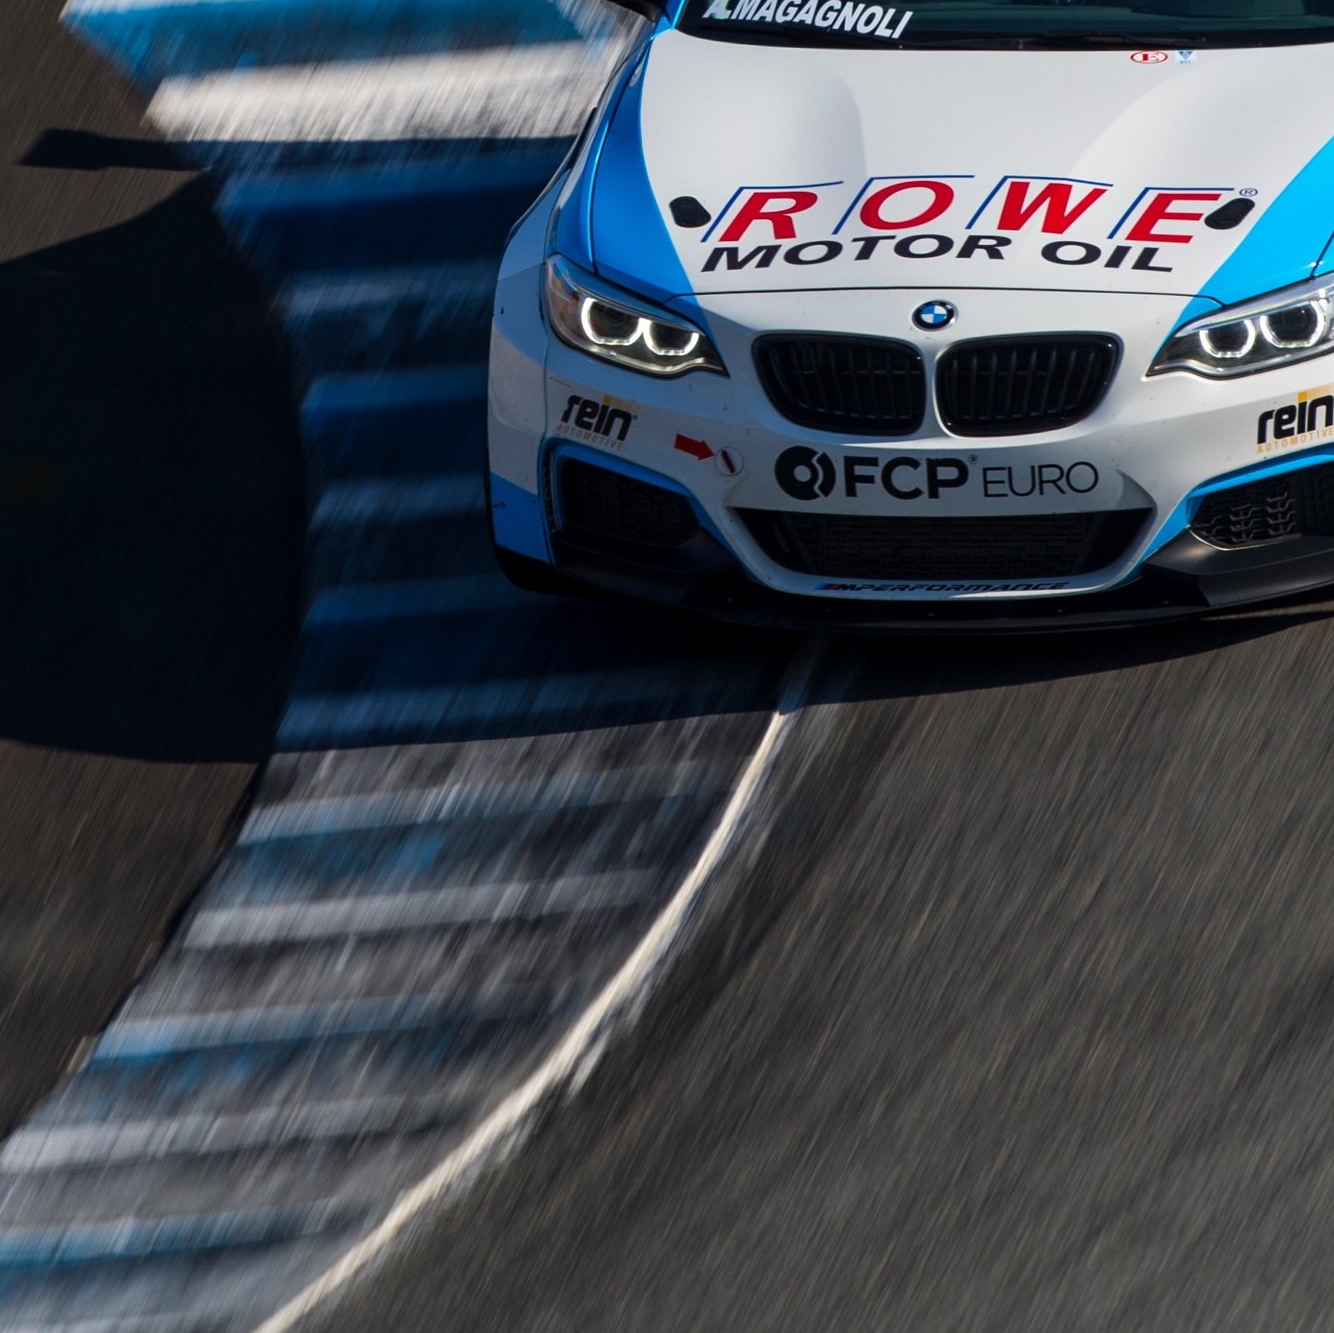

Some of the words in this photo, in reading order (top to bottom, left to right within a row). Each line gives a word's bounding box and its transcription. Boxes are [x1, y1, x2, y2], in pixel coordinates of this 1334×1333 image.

[717, 179, 1223, 244] ROWE
[701, 234, 1012, 273] MOTOR
[1041, 241, 1173, 273] OIL
[556, 423, 625, 450] AUTOMOTIVE
[561, 395, 632, 441] rein
[1257, 390, 1334, 444] rein
[1257, 427, 1334, 454] AUTOMOTIVE
[844, 456, 967, 499] FCP
[982, 461, 1099, 498] EURO
